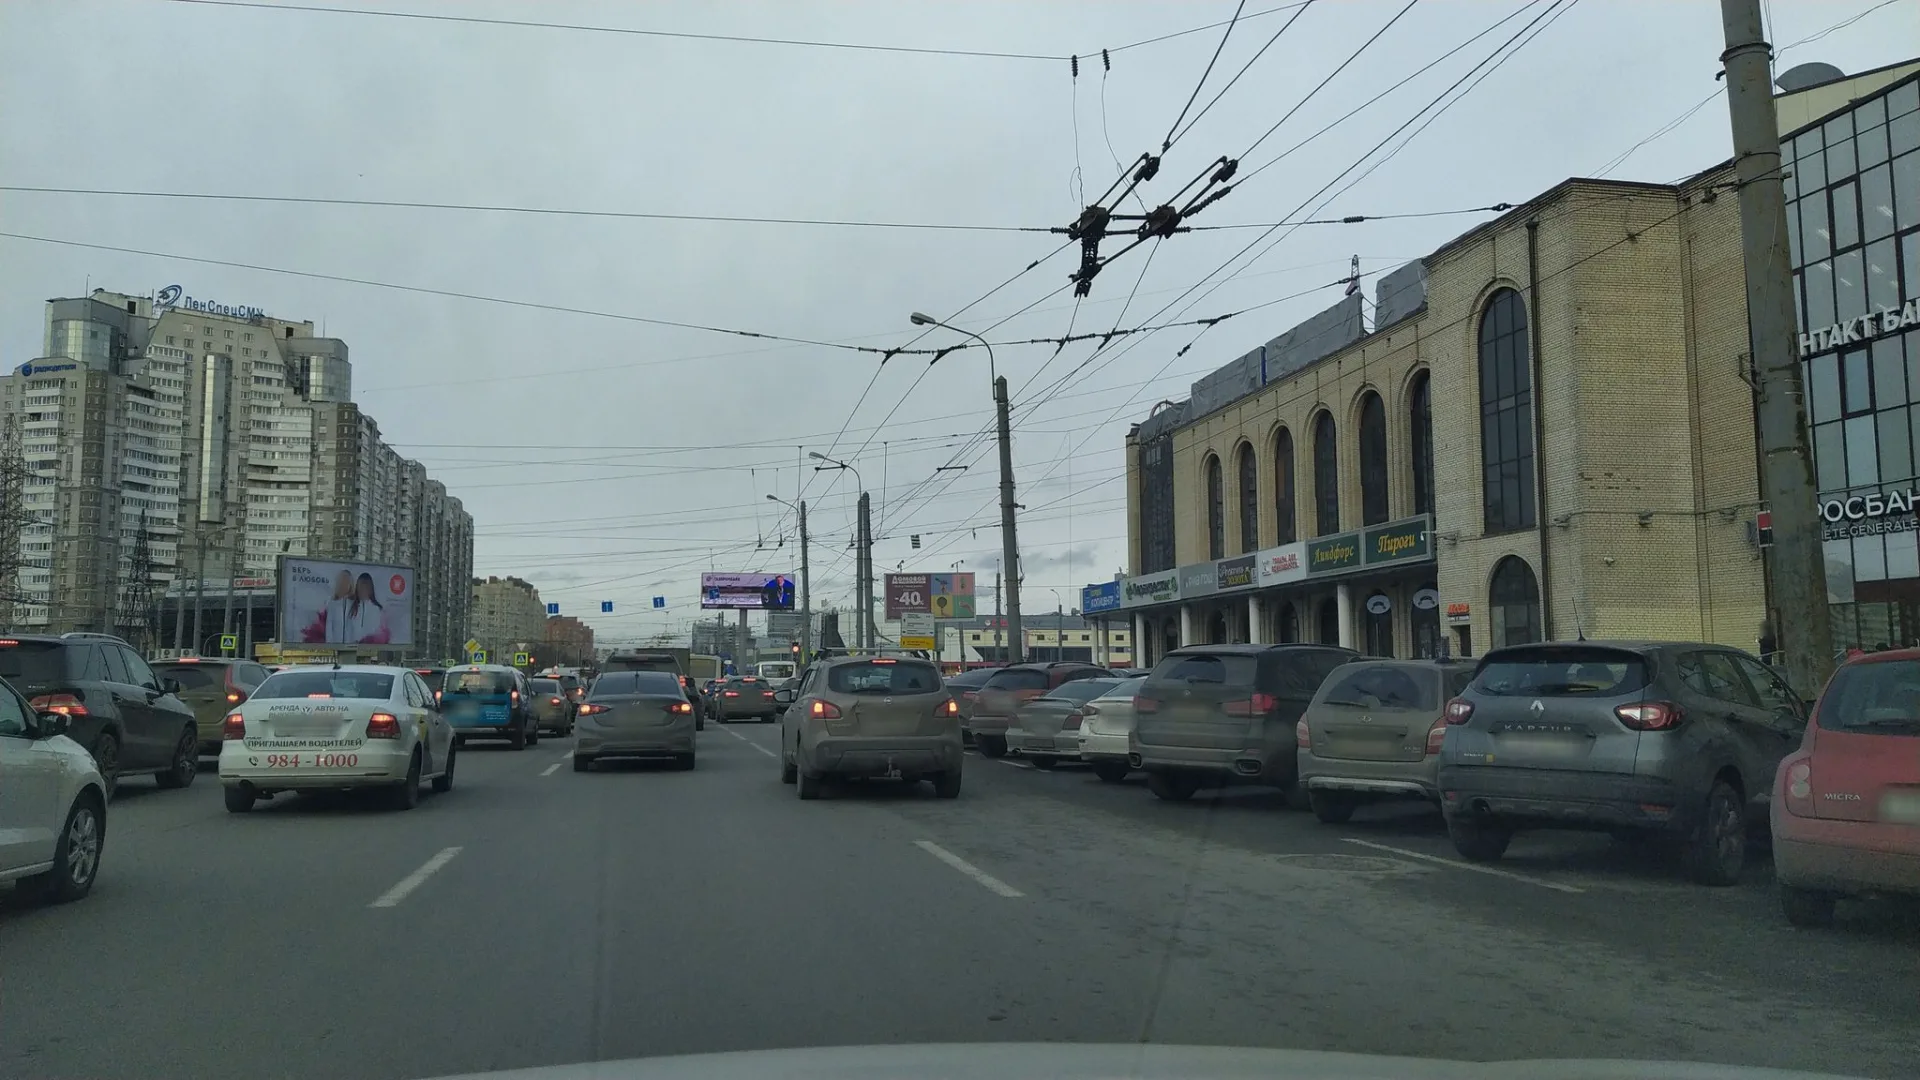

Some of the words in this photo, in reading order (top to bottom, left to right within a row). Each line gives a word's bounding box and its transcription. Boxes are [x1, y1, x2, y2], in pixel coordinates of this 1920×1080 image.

[185, 296, 264, 318] ЛенСпецСМУ
[1882, 297, 1920, 333] БА
[1850, 517, 1919, 537] GENERALE
[1377, 533, 1415, 556] Пироги
[269, 704, 300, 712] АРЕНДА
[314, 704, 335, 712] АВТО
[248, 739, 307, 748] ПРИГЛАШАЕМ
[308, 738, 362, 747] ВОДИТЕЛЕЙ
[1824, 792, 1861, 801] MICRA
